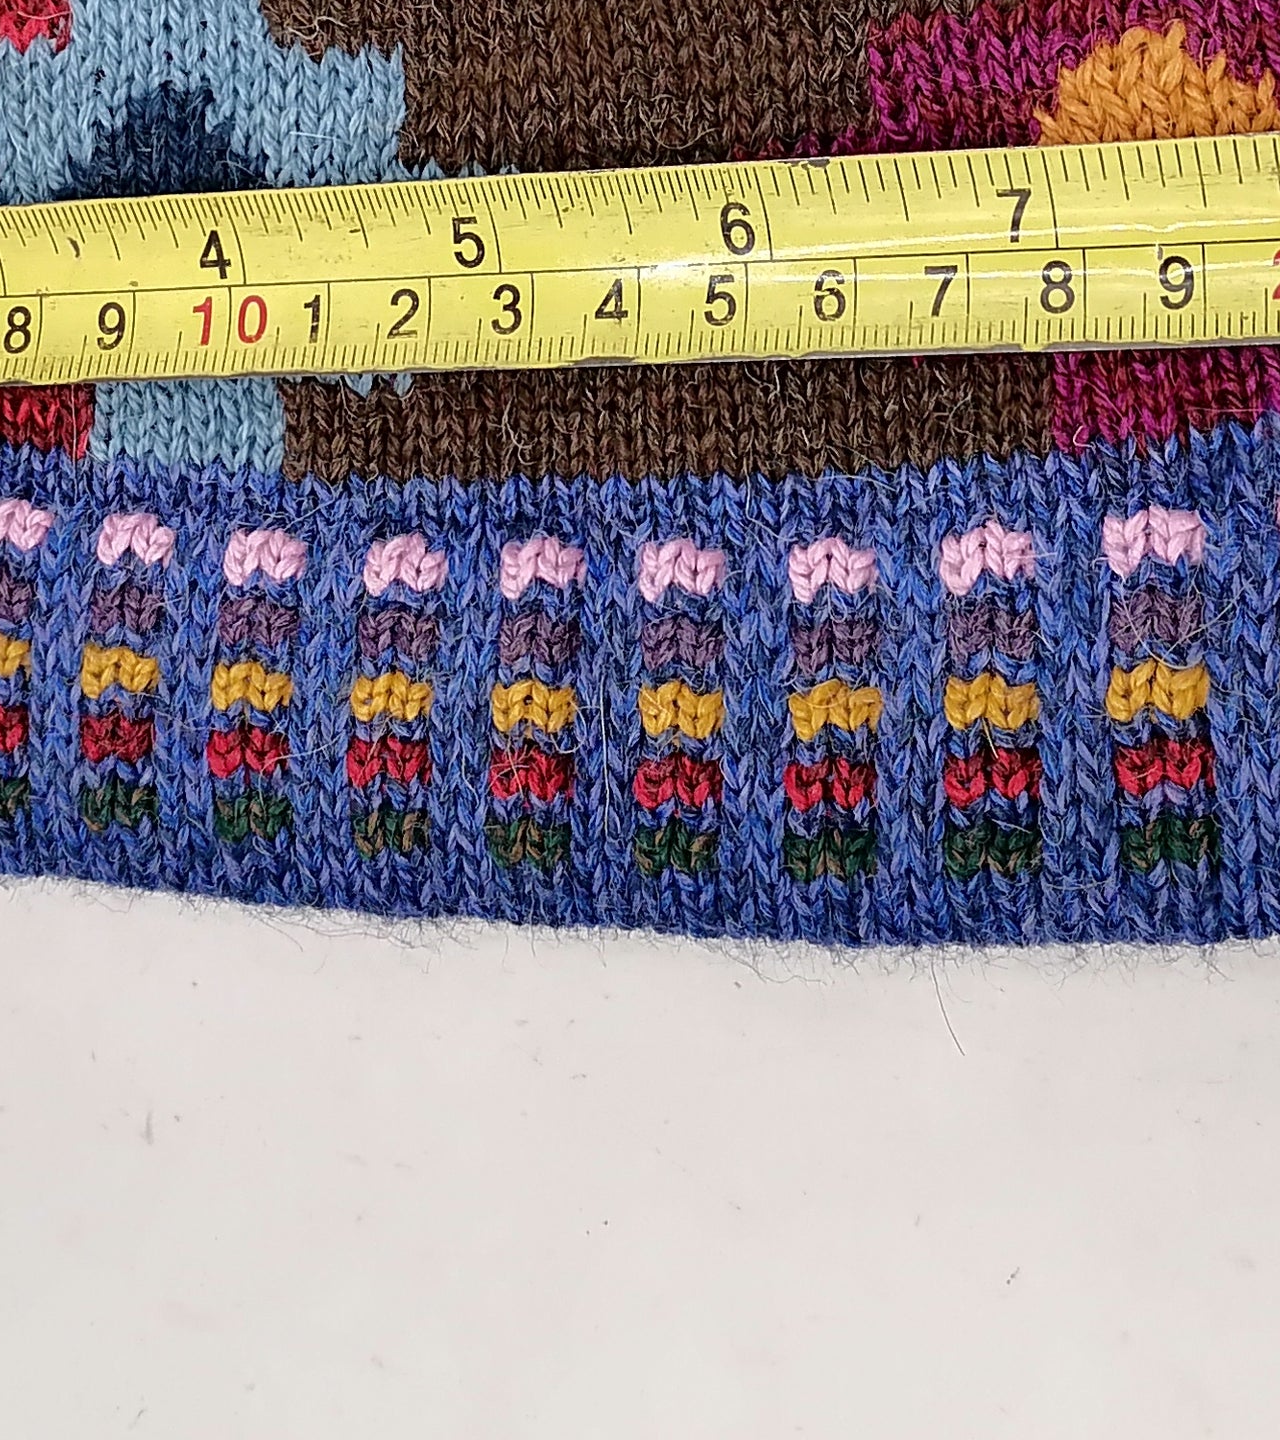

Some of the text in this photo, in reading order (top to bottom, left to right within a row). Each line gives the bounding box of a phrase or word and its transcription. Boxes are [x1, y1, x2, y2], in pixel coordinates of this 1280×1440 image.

[199, 229, 232, 280] 4
[451, 216, 486, 268] 5
[719, 201, 756, 256] 6
[995, 188, 1032, 244] 7
[3, 306, 32, 354] 8
[97, 302, 127, 351] 9
[192, 294, 268, 346] 10
[302, 294, 322, 344] 1
[386, 288, 421, 340] 2
[490, 283, 523, 336] 3
[594, 277, 629, 322] 4
[703, 274, 738, 327] 5
[813, 269, 847, 322] 6
[923, 265, 959, 318] 7
[1039, 260, 1076, 315] 8
[1158, 254, 1196, 310] 9
